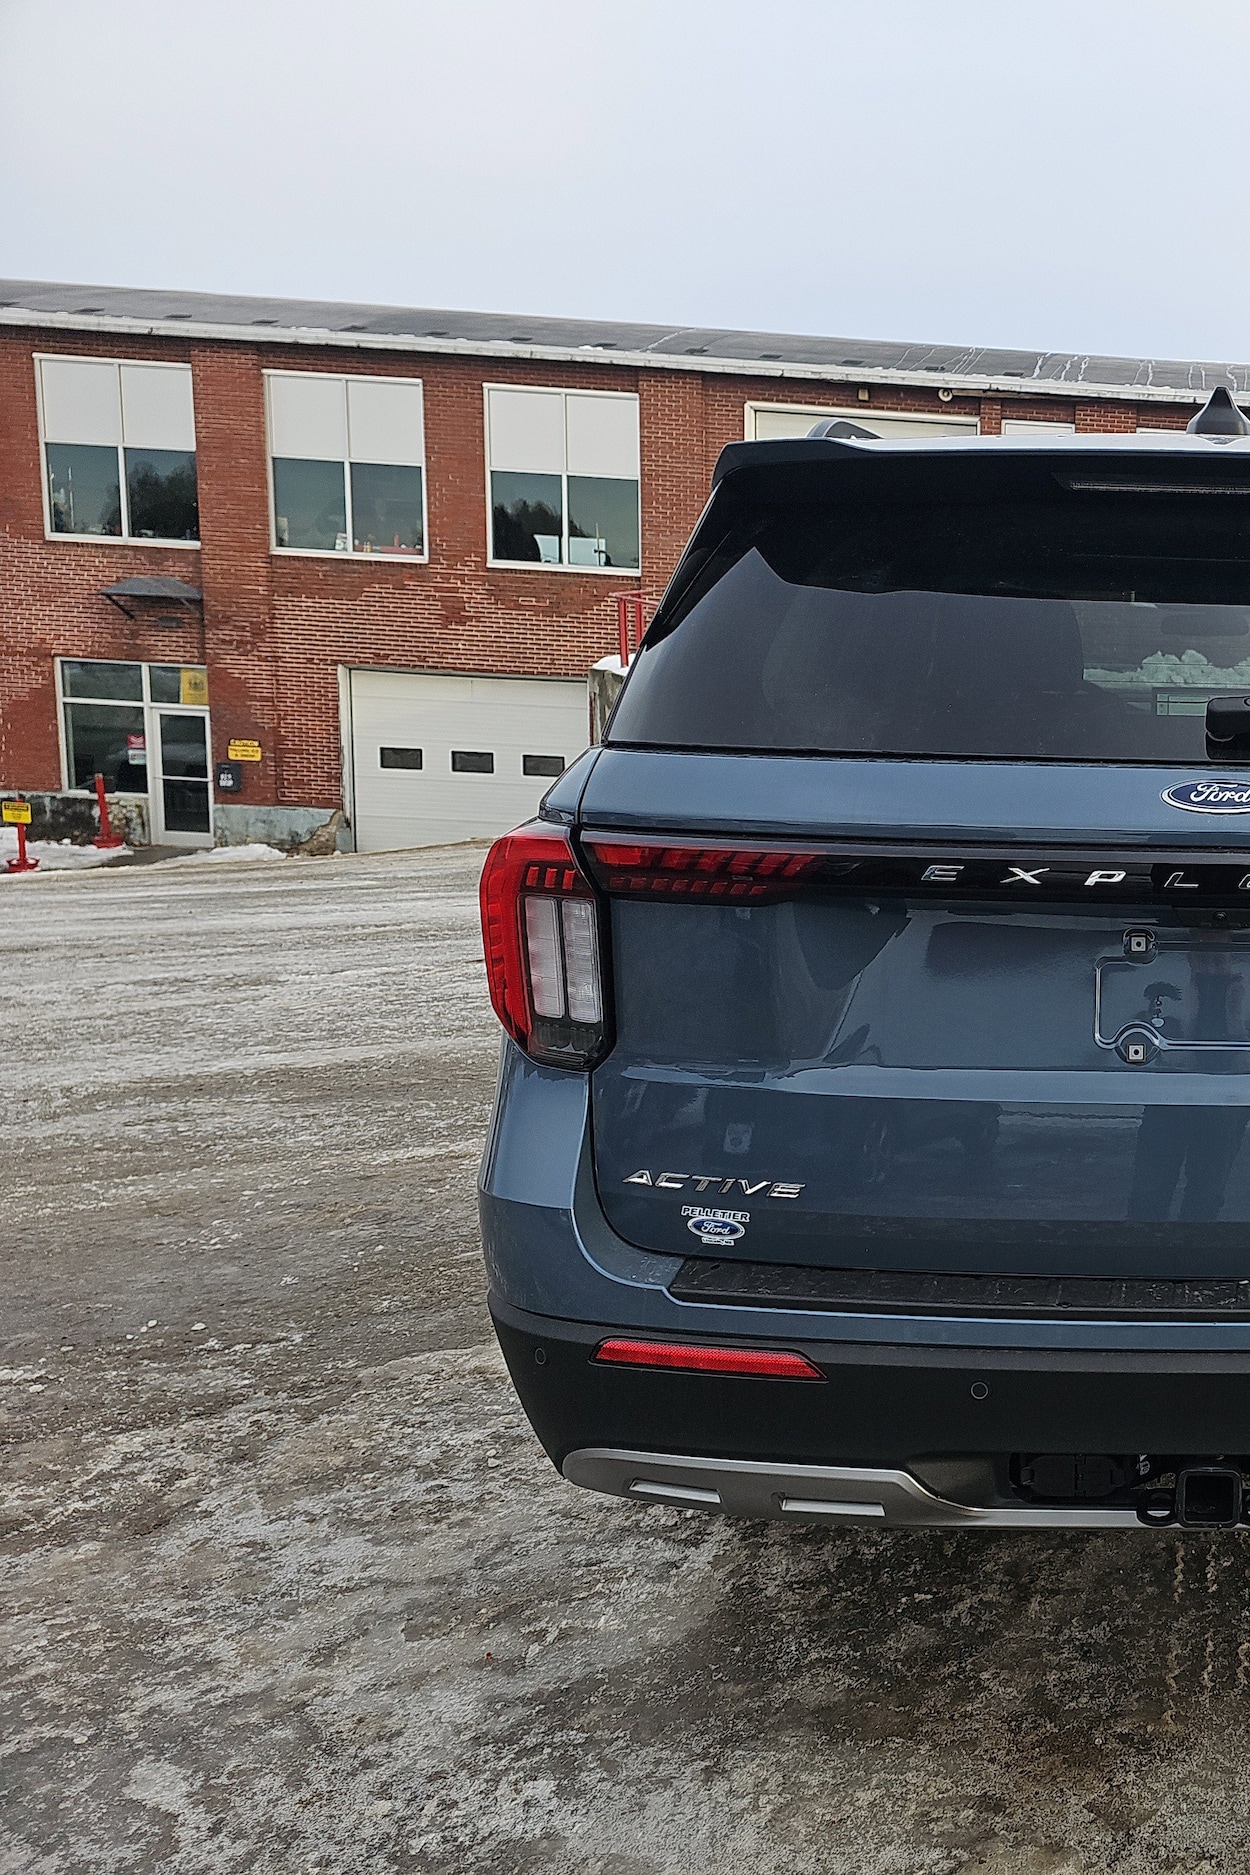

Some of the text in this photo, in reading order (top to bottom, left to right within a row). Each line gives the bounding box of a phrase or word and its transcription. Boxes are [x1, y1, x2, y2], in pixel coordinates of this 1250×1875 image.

[622, 1169, 806, 1198] ACTIVE
[682, 1206, 750, 1222] PELLETIER
[701, 1221, 731, 1235] Ford
